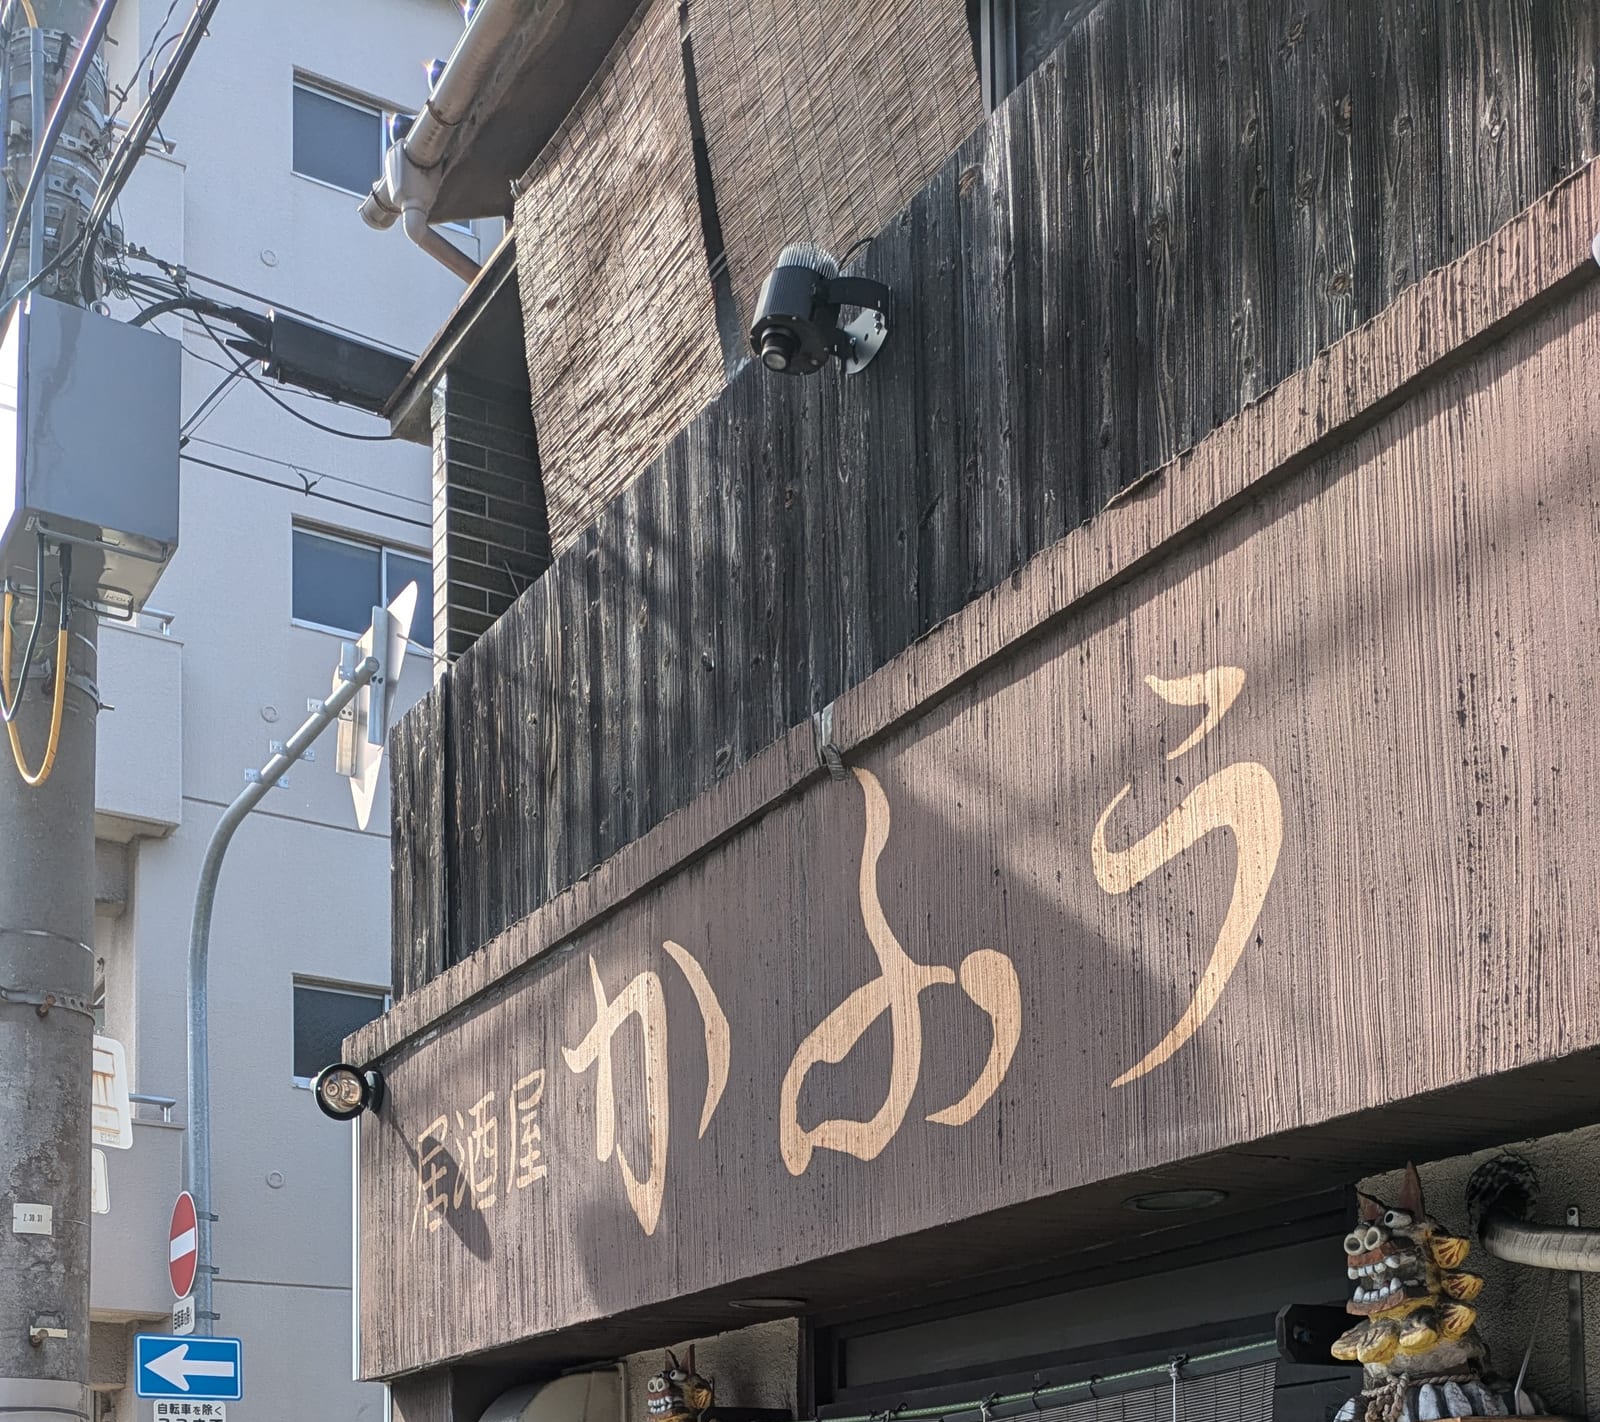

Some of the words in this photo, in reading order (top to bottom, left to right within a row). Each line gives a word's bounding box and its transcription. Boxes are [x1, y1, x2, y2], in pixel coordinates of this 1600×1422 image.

[410, 1068, 548, 1243] 居酒屋
[157, 1403, 222, 1416] 自転車を除く
